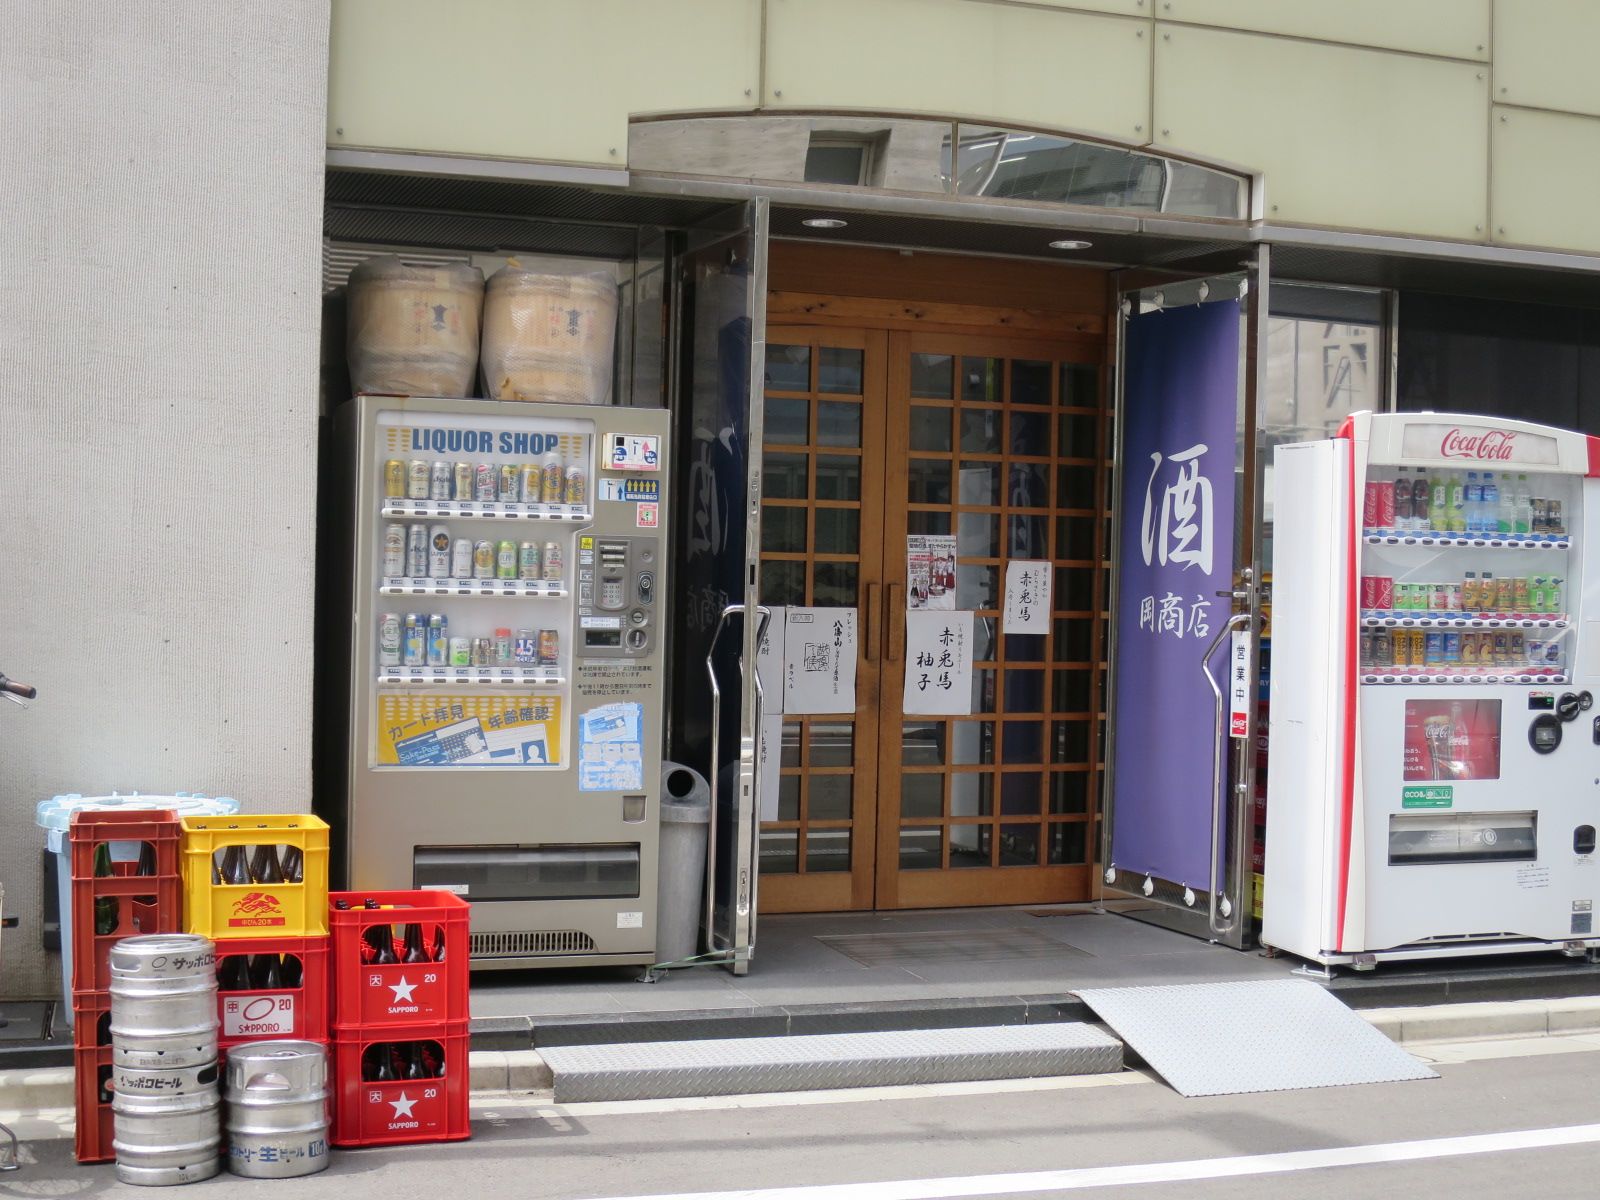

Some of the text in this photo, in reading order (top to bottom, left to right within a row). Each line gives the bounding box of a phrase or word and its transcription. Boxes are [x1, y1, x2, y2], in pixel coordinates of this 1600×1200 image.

[412, 428, 559, 455] LIQUOR SHOP
[1440, 428, 1517, 460] Coca-Cola
[1141, 443, 1214, 576] 酒
[1140, 592, 1212, 639] 岡商店
[916, 651, 934, 691] 柚子
[1235, 644, 1245, 701] 営業中
[388, 704, 465, 741] カード拝見
[488, 706, 550, 729] 年齢確認
[371, 975, 382, 986] 大
[424, 974, 437, 983] 20
[228, 1001, 239, 1013] 中
[278, 999, 291, 1011] 20
[388, 1006, 419, 1014] SAPPORO
[371, 1091, 382, 1102] 大
[424, 1088, 437, 1098] 20
[388, 1121, 419, 1130] SAPPORO
